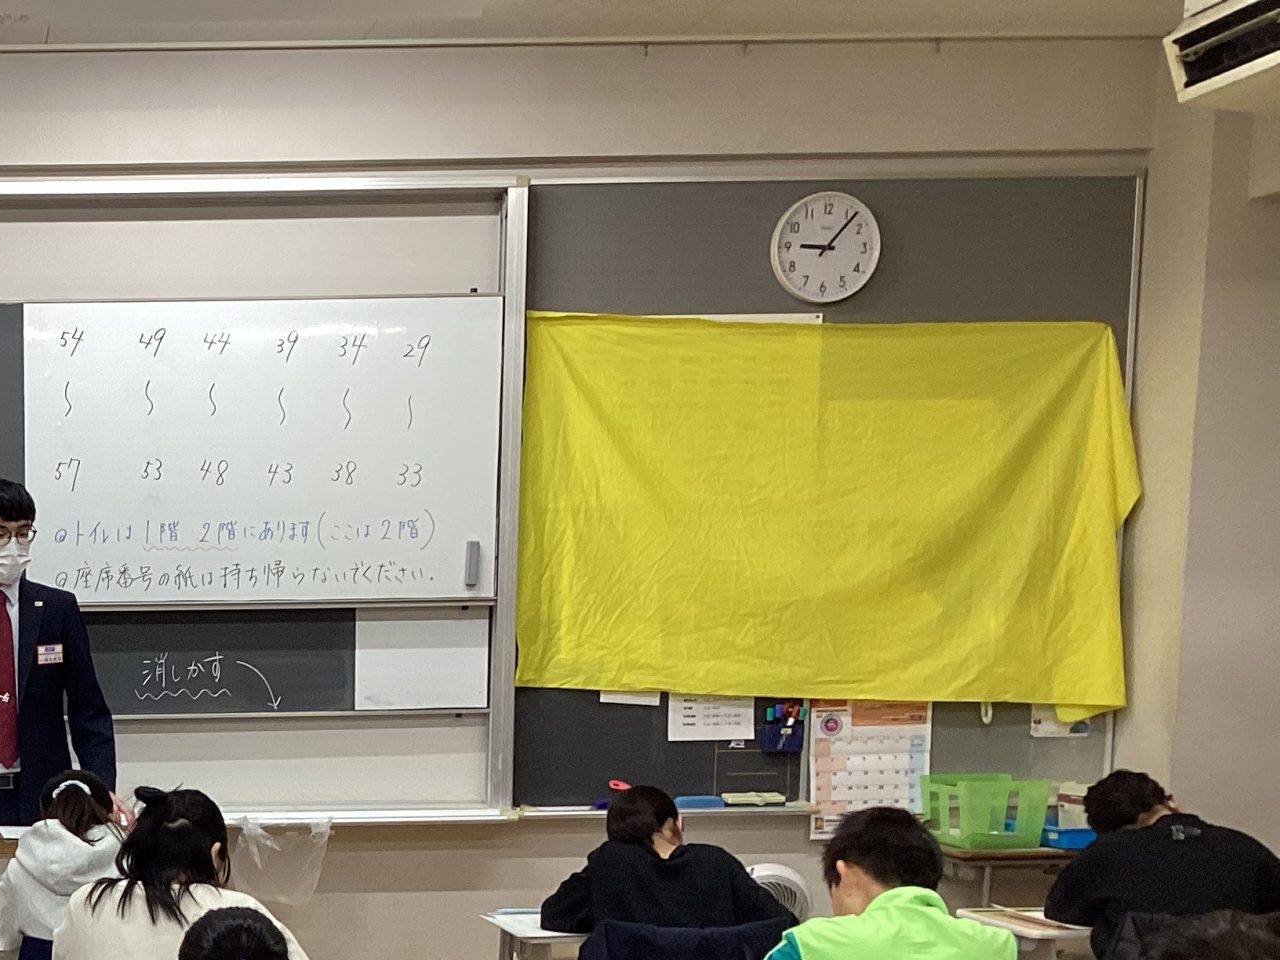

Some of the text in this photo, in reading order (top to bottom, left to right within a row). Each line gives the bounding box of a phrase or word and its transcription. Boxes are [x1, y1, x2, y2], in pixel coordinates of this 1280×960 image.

[58, 326, 85, 357] 54
[138, 327, 167, 357] 49
[203, 328, 232, 356] 44
[275, 329, 299, 363] 39
[338, 332, 368, 366] 34
[402, 334, 432, 367] 29
[54, 457, 81, 492] 57
[141, 457, 163, 482] 53
[199, 458, 229, 487] 48
[267, 462, 293, 486] 43
[330, 459, 357, 485] 38
[396, 462, 423, 488] 33
[142, 651, 224, 688] 消しかす
